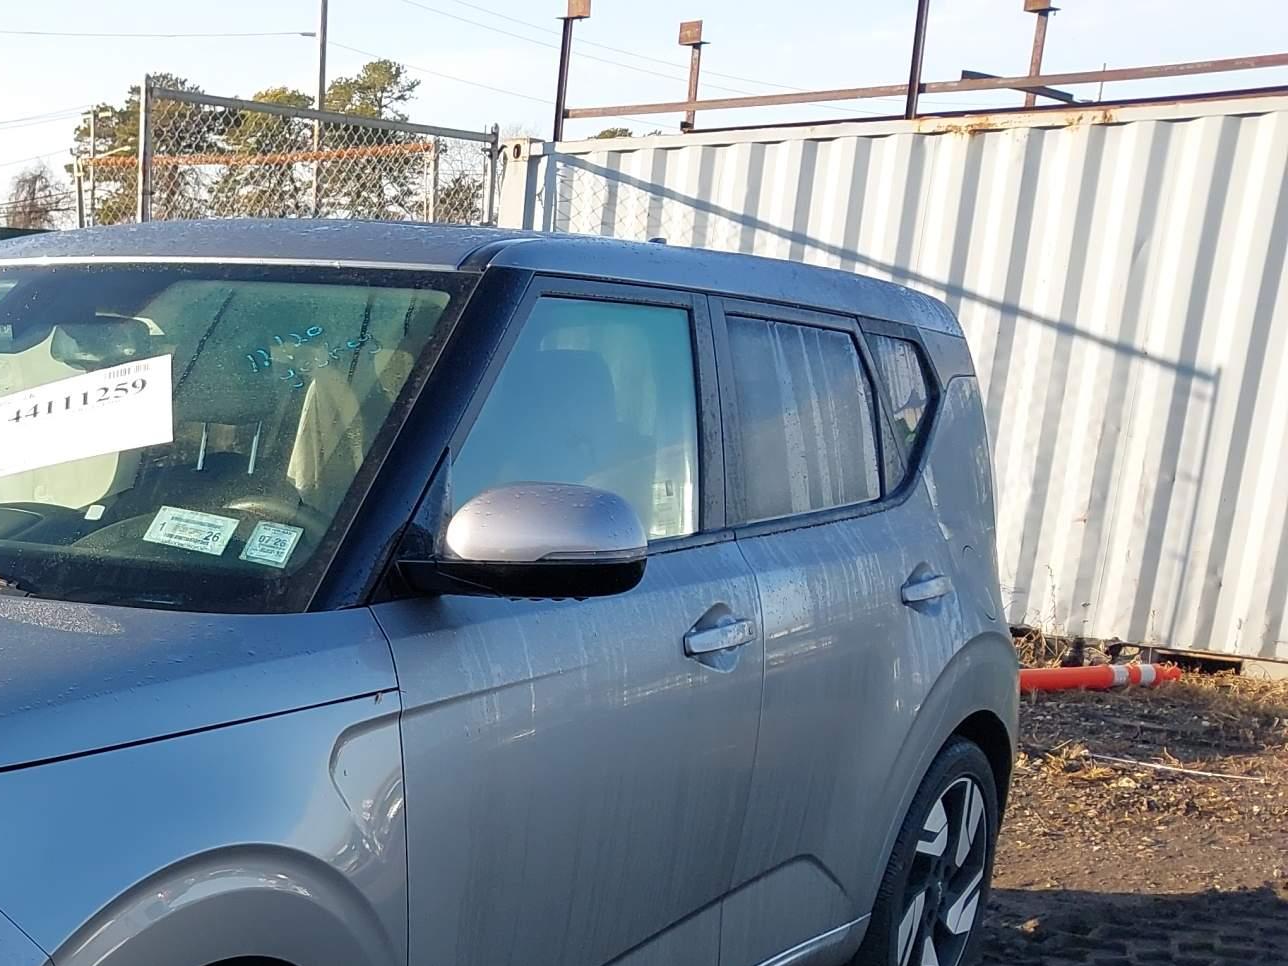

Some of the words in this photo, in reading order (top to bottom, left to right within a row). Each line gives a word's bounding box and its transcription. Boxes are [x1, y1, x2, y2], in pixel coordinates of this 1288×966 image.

[8, 378, 147, 423] 44111259
[203, 531, 221, 542] 26
[258, 535, 272, 544] 07
[273, 537, 288, 547] 26
